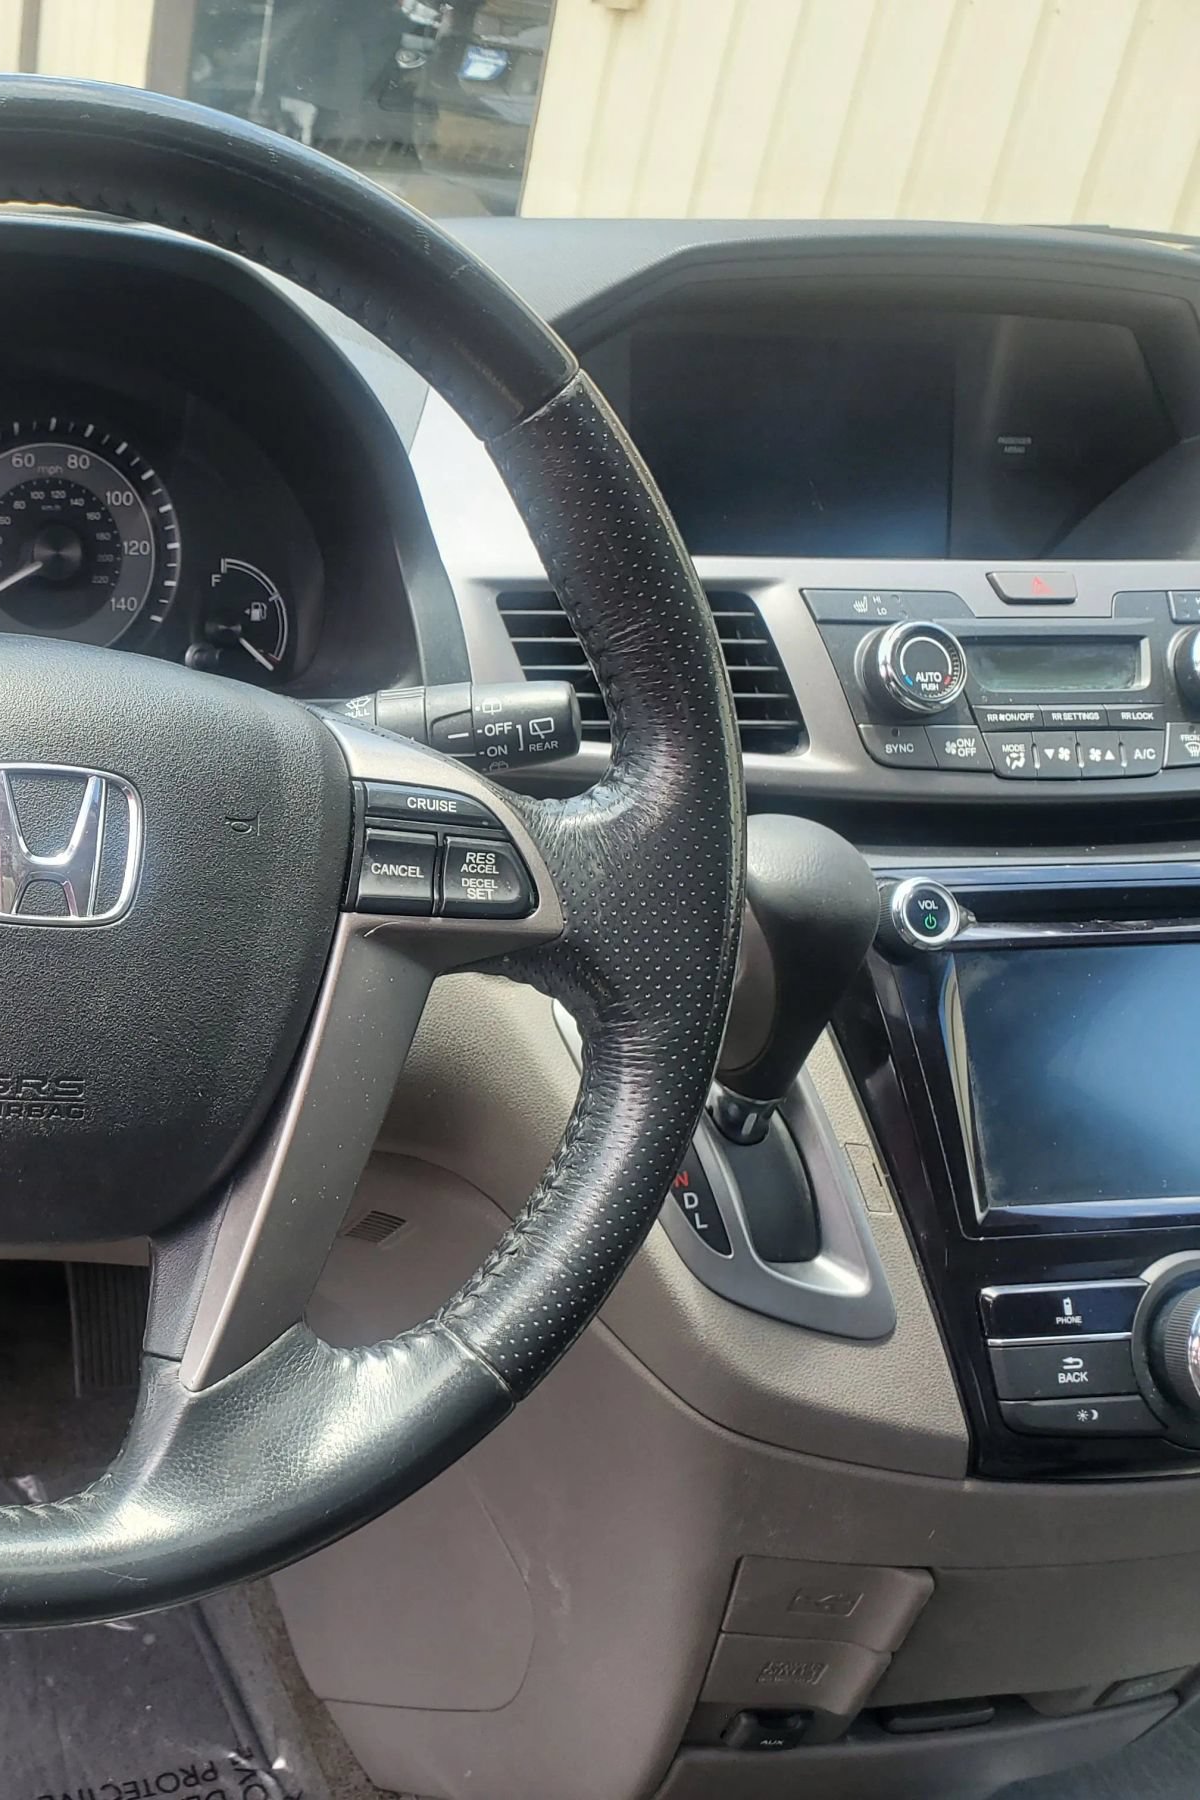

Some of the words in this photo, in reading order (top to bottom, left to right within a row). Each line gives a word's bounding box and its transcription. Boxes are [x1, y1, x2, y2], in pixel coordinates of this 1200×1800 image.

[12, 453, 35, 468] 60
[67, 454, 90, 470] 80
[37, 465, 63, 475] mph
[105, 491, 133, 506] 100
[123, 541, 150, 556] 120
[211, 574, 222, 587] F
[111, 597, 138, 611] 140
[915, 672, 942, 682] AUTO
[921, 683, 939, 691] PUSH
[987, 713, 998, 722] RR
[1005, 712, 1035, 722] ON/OFF
[1051, 712, 1062, 720] RR
[1063, 712, 1100, 721] SETTINGS
[1121, 712, 1130, 720] RR
[1131, 712, 1154, 720] LOCK
[484, 722, 513, 736] OFF
[486, 745, 508, 757] ON
[529, 741, 558, 752] REAR
[885, 743, 915, 754] SYNC
[957, 747, 976, 757] OFF
[1002, 744, 1025, 752] MODE
[1134, 748, 1156, 760] A/C
[407, 797, 457, 812] CRUISE
[465, 853, 496, 865] RES
[371, 863, 424, 878] CANCEL
[460, 864, 499, 875] ACCEL
[462, 878, 498, 889] DECEL
[467, 888, 494, 900] SET
[918, 900, 939, 910] VOL
[673, 1171, 689, 1187] N
[683, 1192, 699, 1209] D
[694, 1213, 708, 1230] L
[1056, 1316, 1083, 1324] PHONE
[1058, 1372, 1088, 1383] BACK
